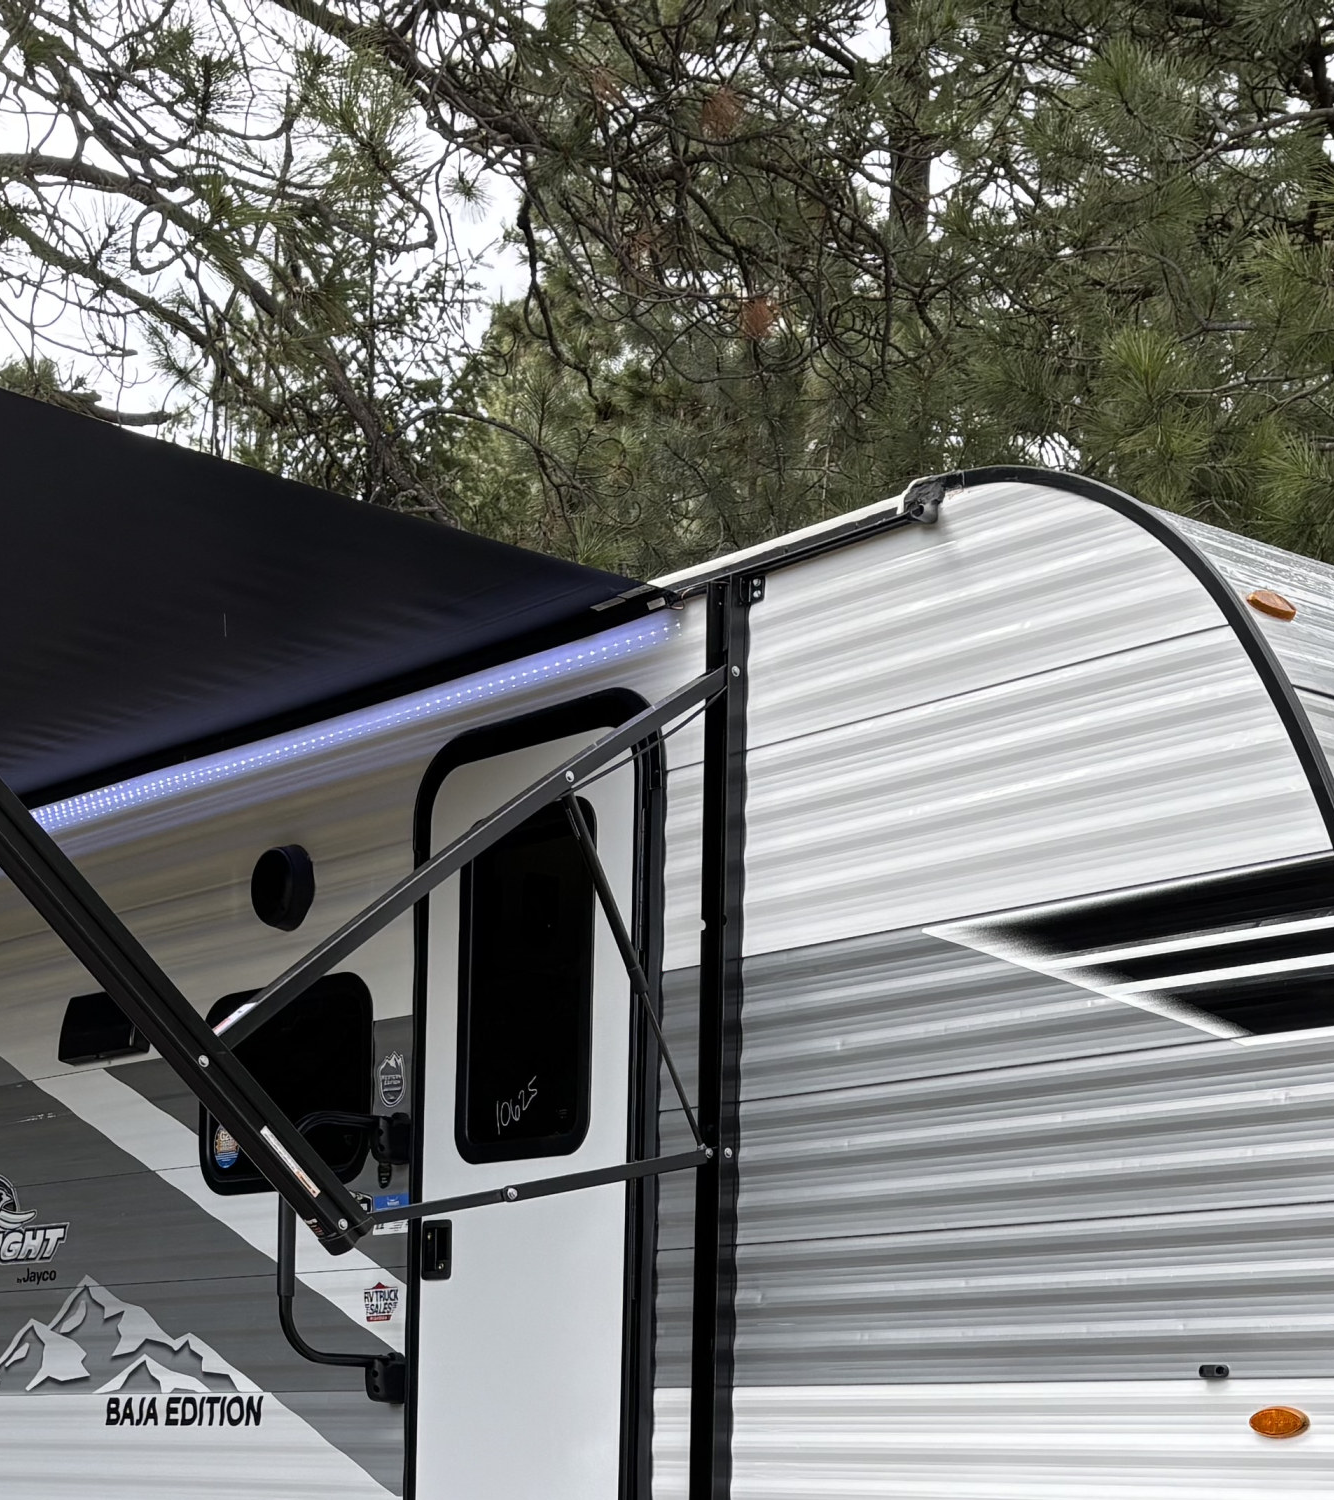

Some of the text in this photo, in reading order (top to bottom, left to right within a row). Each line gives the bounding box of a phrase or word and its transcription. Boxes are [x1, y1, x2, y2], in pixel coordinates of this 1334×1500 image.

[496, 1075, 538, 1135] 10625
[23, 1268, 57, 1285] Jayco
[364, 1288, 399, 1302] RV TRUCK
[370, 1302, 393, 1315] SALES
[105, 1396, 264, 1426] BAJA EDITION
